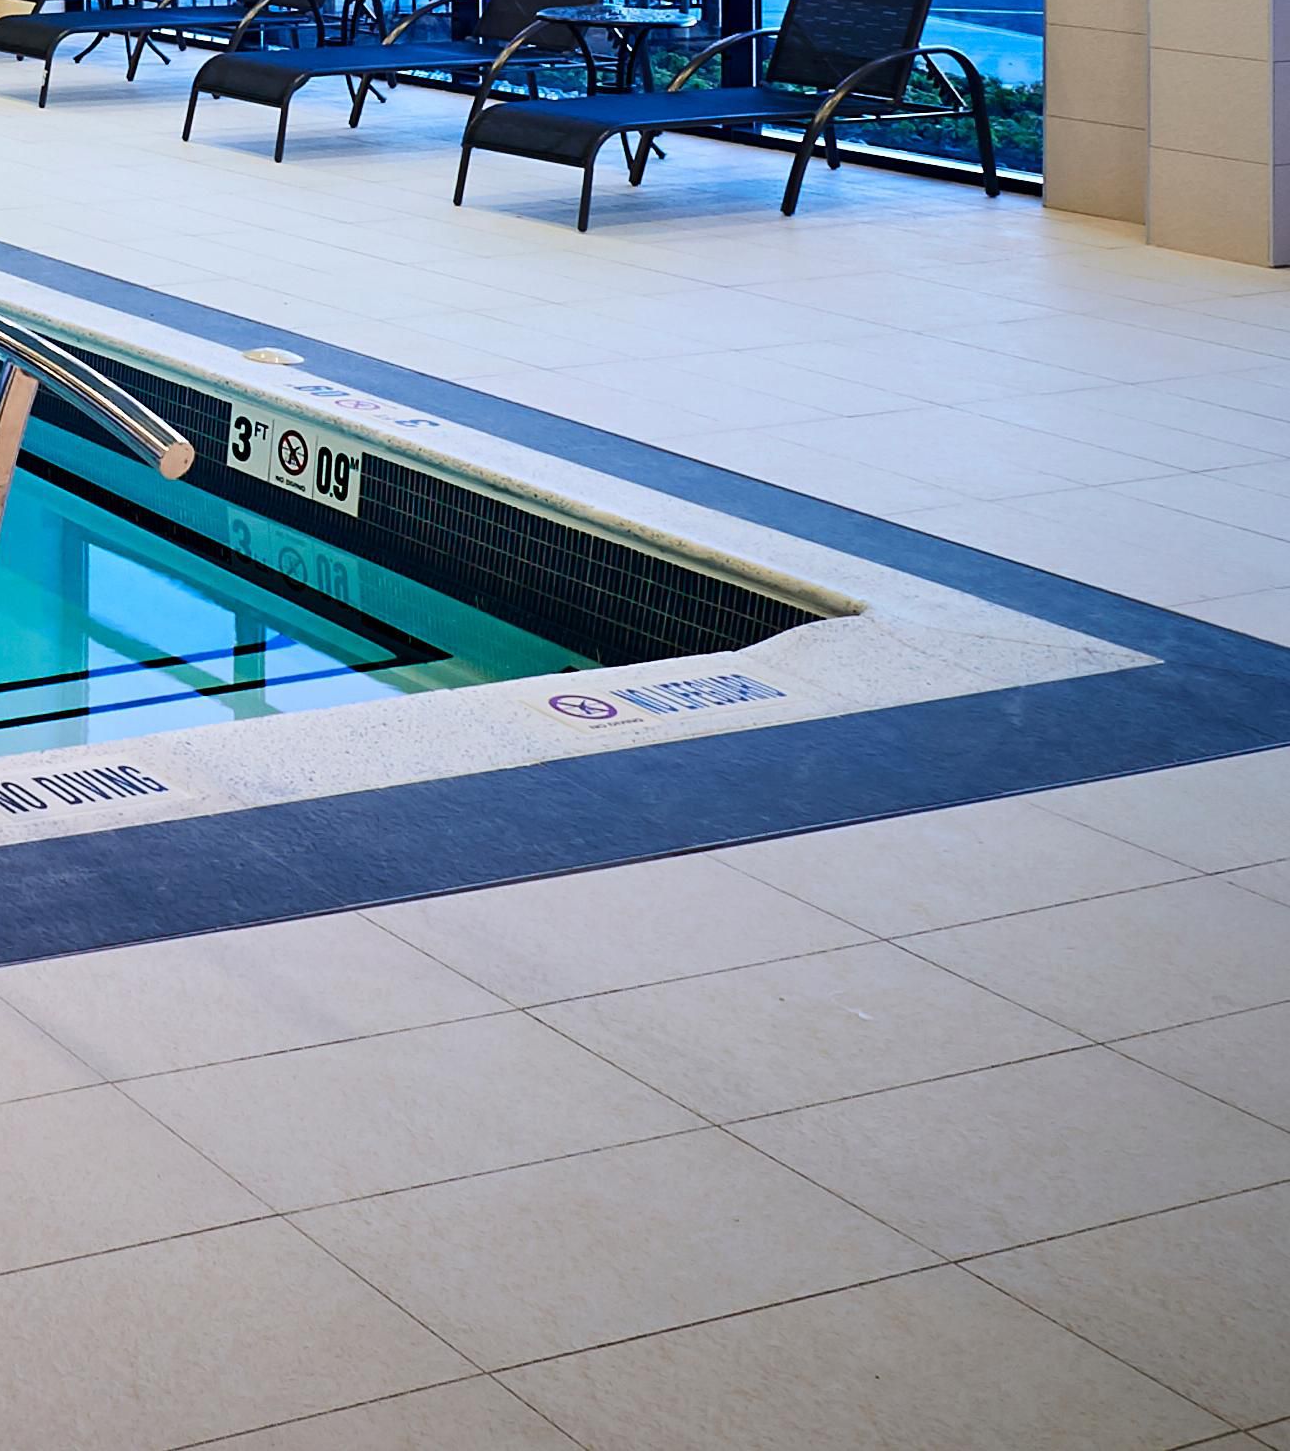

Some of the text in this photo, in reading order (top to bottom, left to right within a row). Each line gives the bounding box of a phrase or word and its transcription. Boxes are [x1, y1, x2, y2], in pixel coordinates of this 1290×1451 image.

[232, 416, 252, 462] 3
[254, 421, 269, 440] FT
[316, 446, 350, 501] 0.9
[610, 674, 787, 715] NO LIFEGUARD
[32, 765, 169, 805] DIVING
